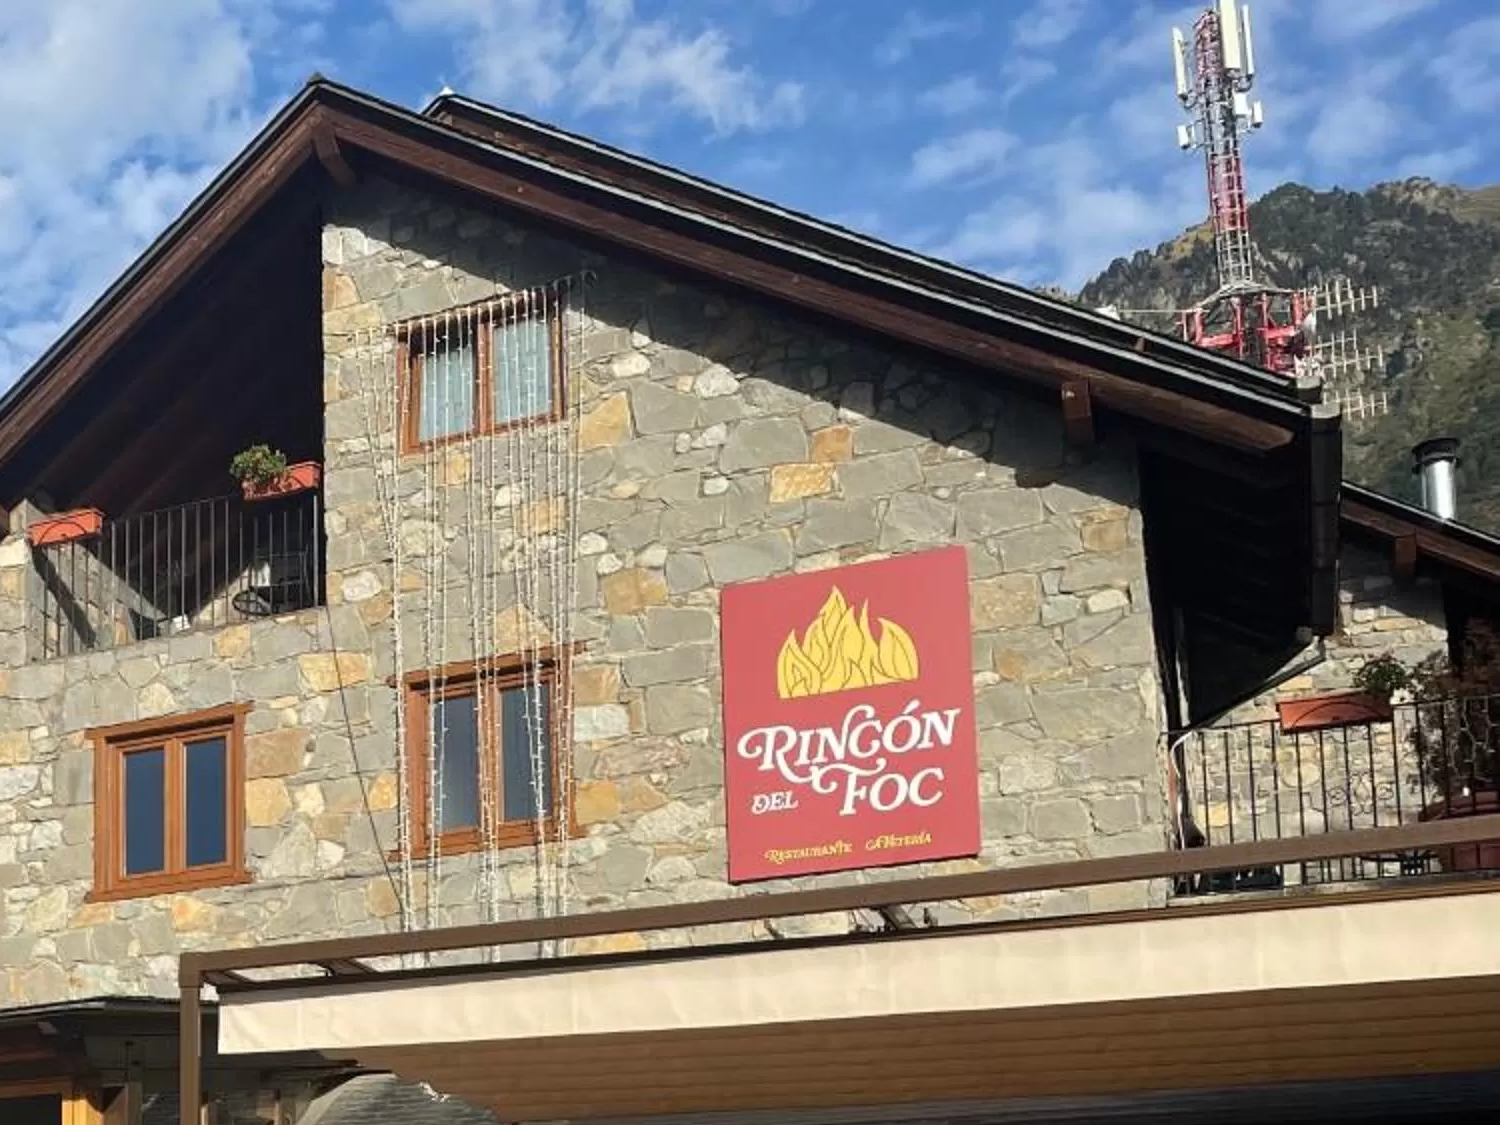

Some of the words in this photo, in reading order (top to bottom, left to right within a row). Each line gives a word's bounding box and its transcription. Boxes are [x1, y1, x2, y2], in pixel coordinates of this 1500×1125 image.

[737, 699, 961, 784] RINCÓN
[751, 790, 798, 815] DEL
[810, 758, 945, 816] FOC
